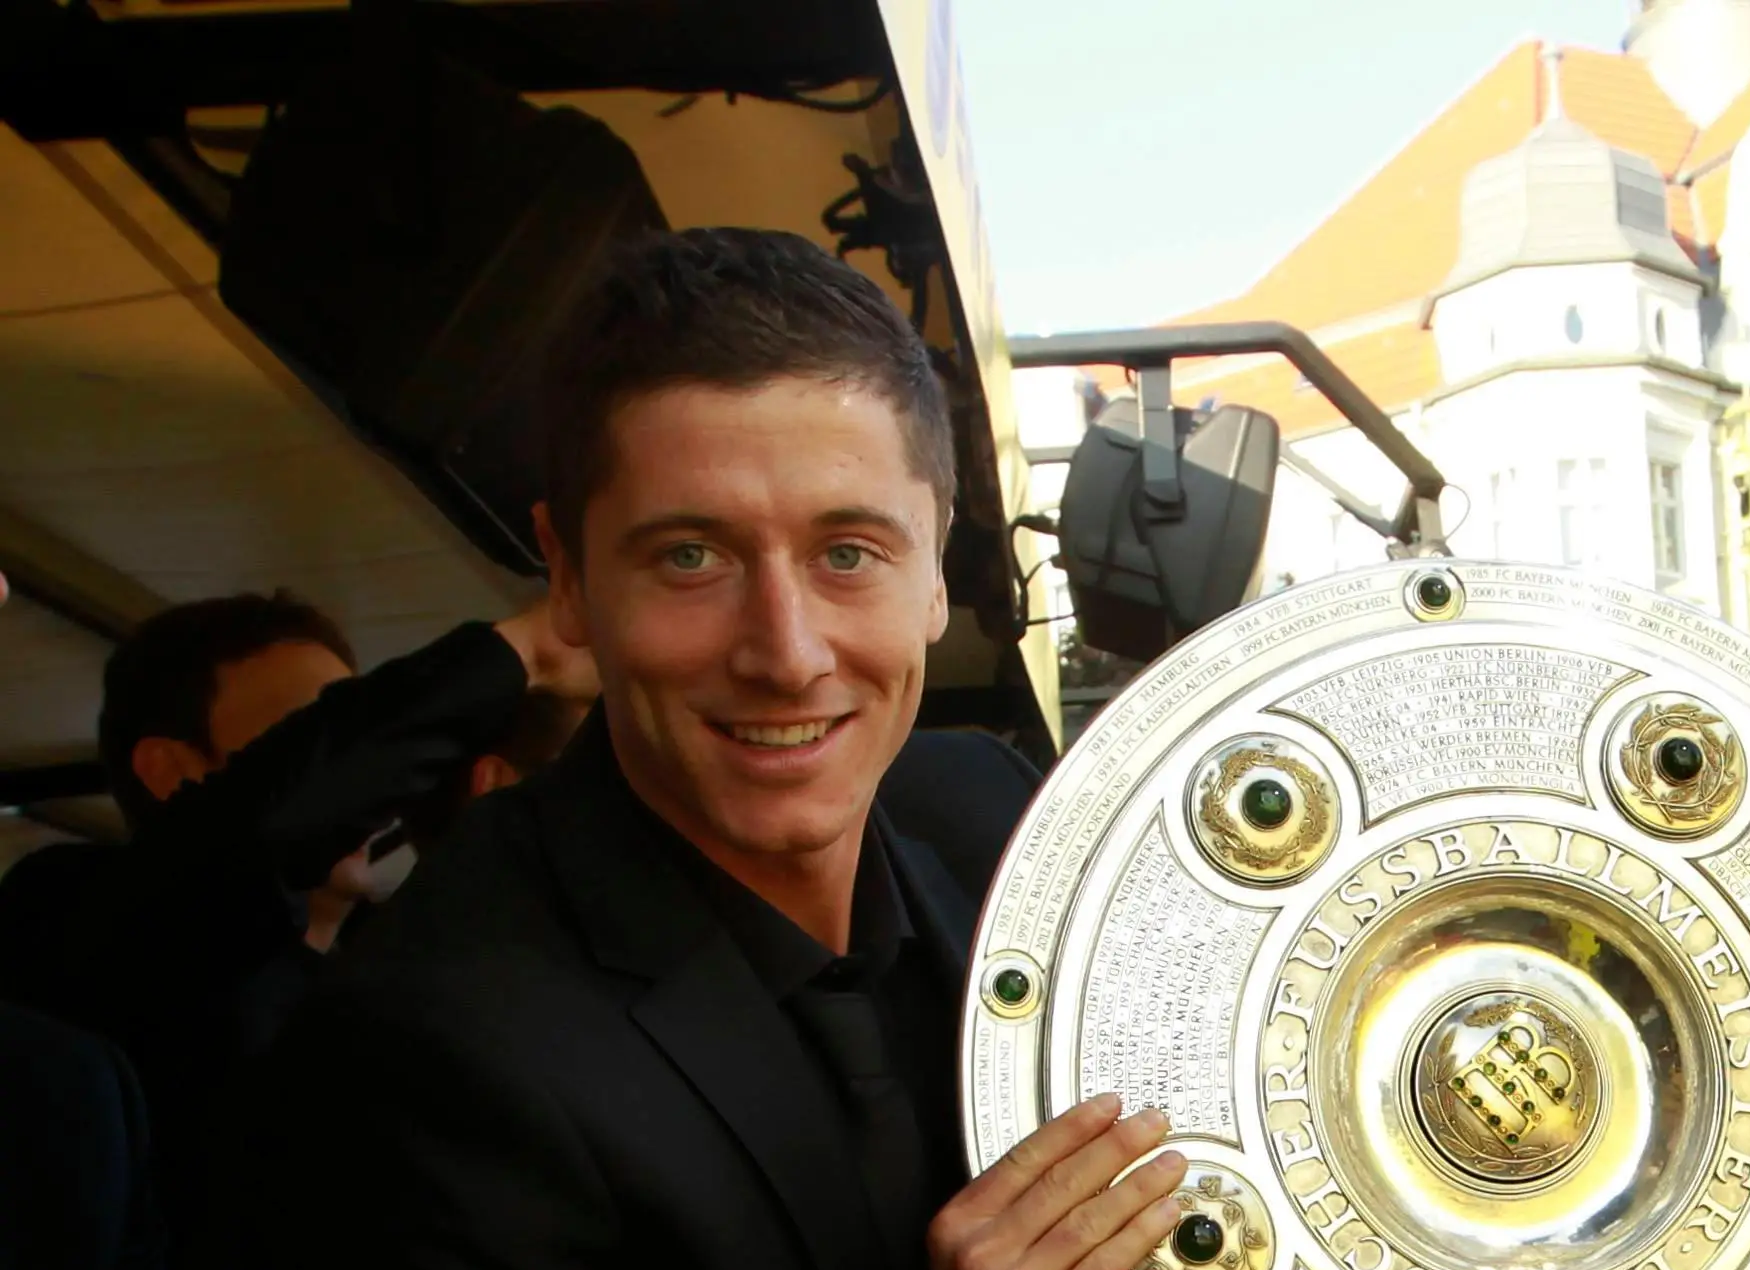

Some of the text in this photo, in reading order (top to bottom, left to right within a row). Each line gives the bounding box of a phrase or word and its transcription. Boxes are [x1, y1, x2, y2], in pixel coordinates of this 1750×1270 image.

[1231, 577, 1374, 639] 1984 VFB STUTTGART
[1239, 592, 1392, 658] 1999 FC BAYERN MÜNCHEN
[1087, 650, 1202, 758] 1983 HSV HAMBURG
[1093, 754, 1121, 784] 1998
[1134, 654, 1233, 736] KAISERSLAUTERN
[994, 793, 1066, 936] 1982 HSV HAMBURG
[1015, 785, 1096, 944] 1997 FC BAYERN MÜNCHEN
[1034, 770, 1133, 952] 2012 BV BORUSSIA DORTMUND
[977, 1025, 991, 1107] DORTMUND
[999, 1039, 1013, 1120] DORTMUND
